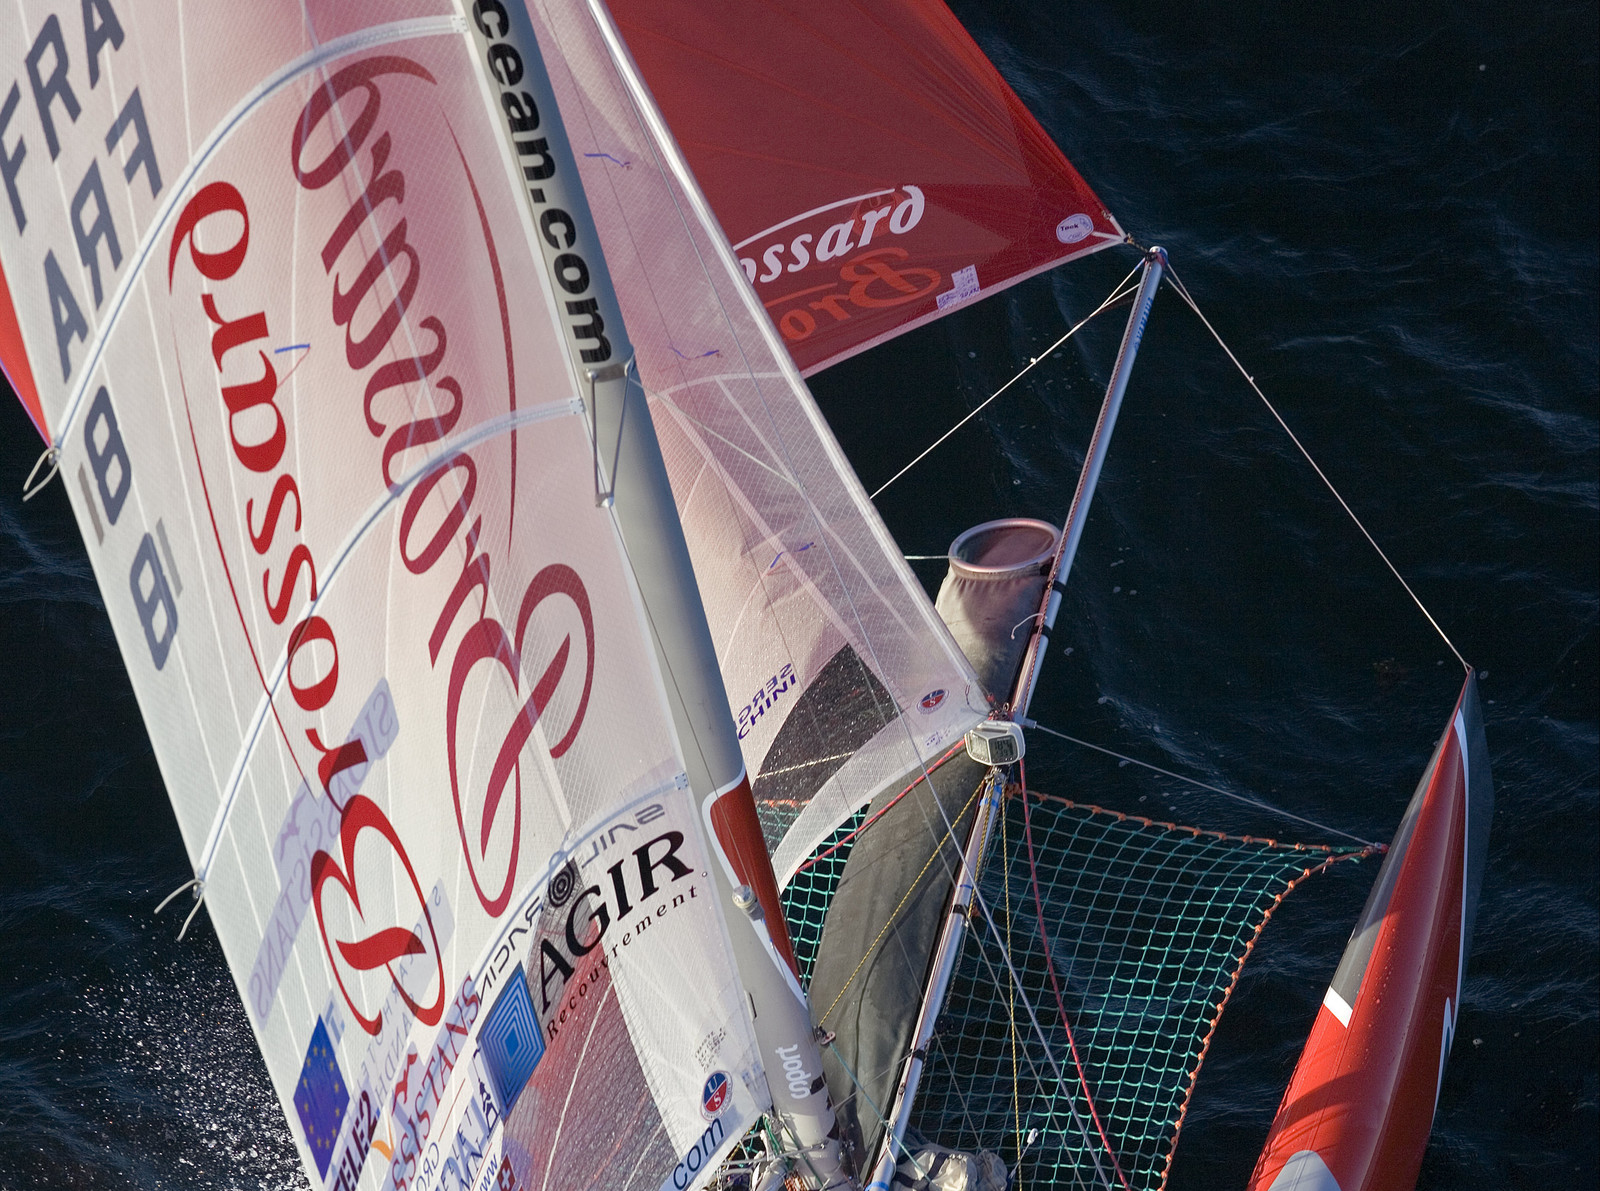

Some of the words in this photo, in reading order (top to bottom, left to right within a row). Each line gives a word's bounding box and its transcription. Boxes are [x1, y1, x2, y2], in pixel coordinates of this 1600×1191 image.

[0, 0, 125, 237] FRA
[473, 0, 612, 364] cean.com
[169, 181, 445, 1036] Brossard
[538, 830, 695, 1015] AGIR
[546, 884, 698, 1042] Recouvrement
